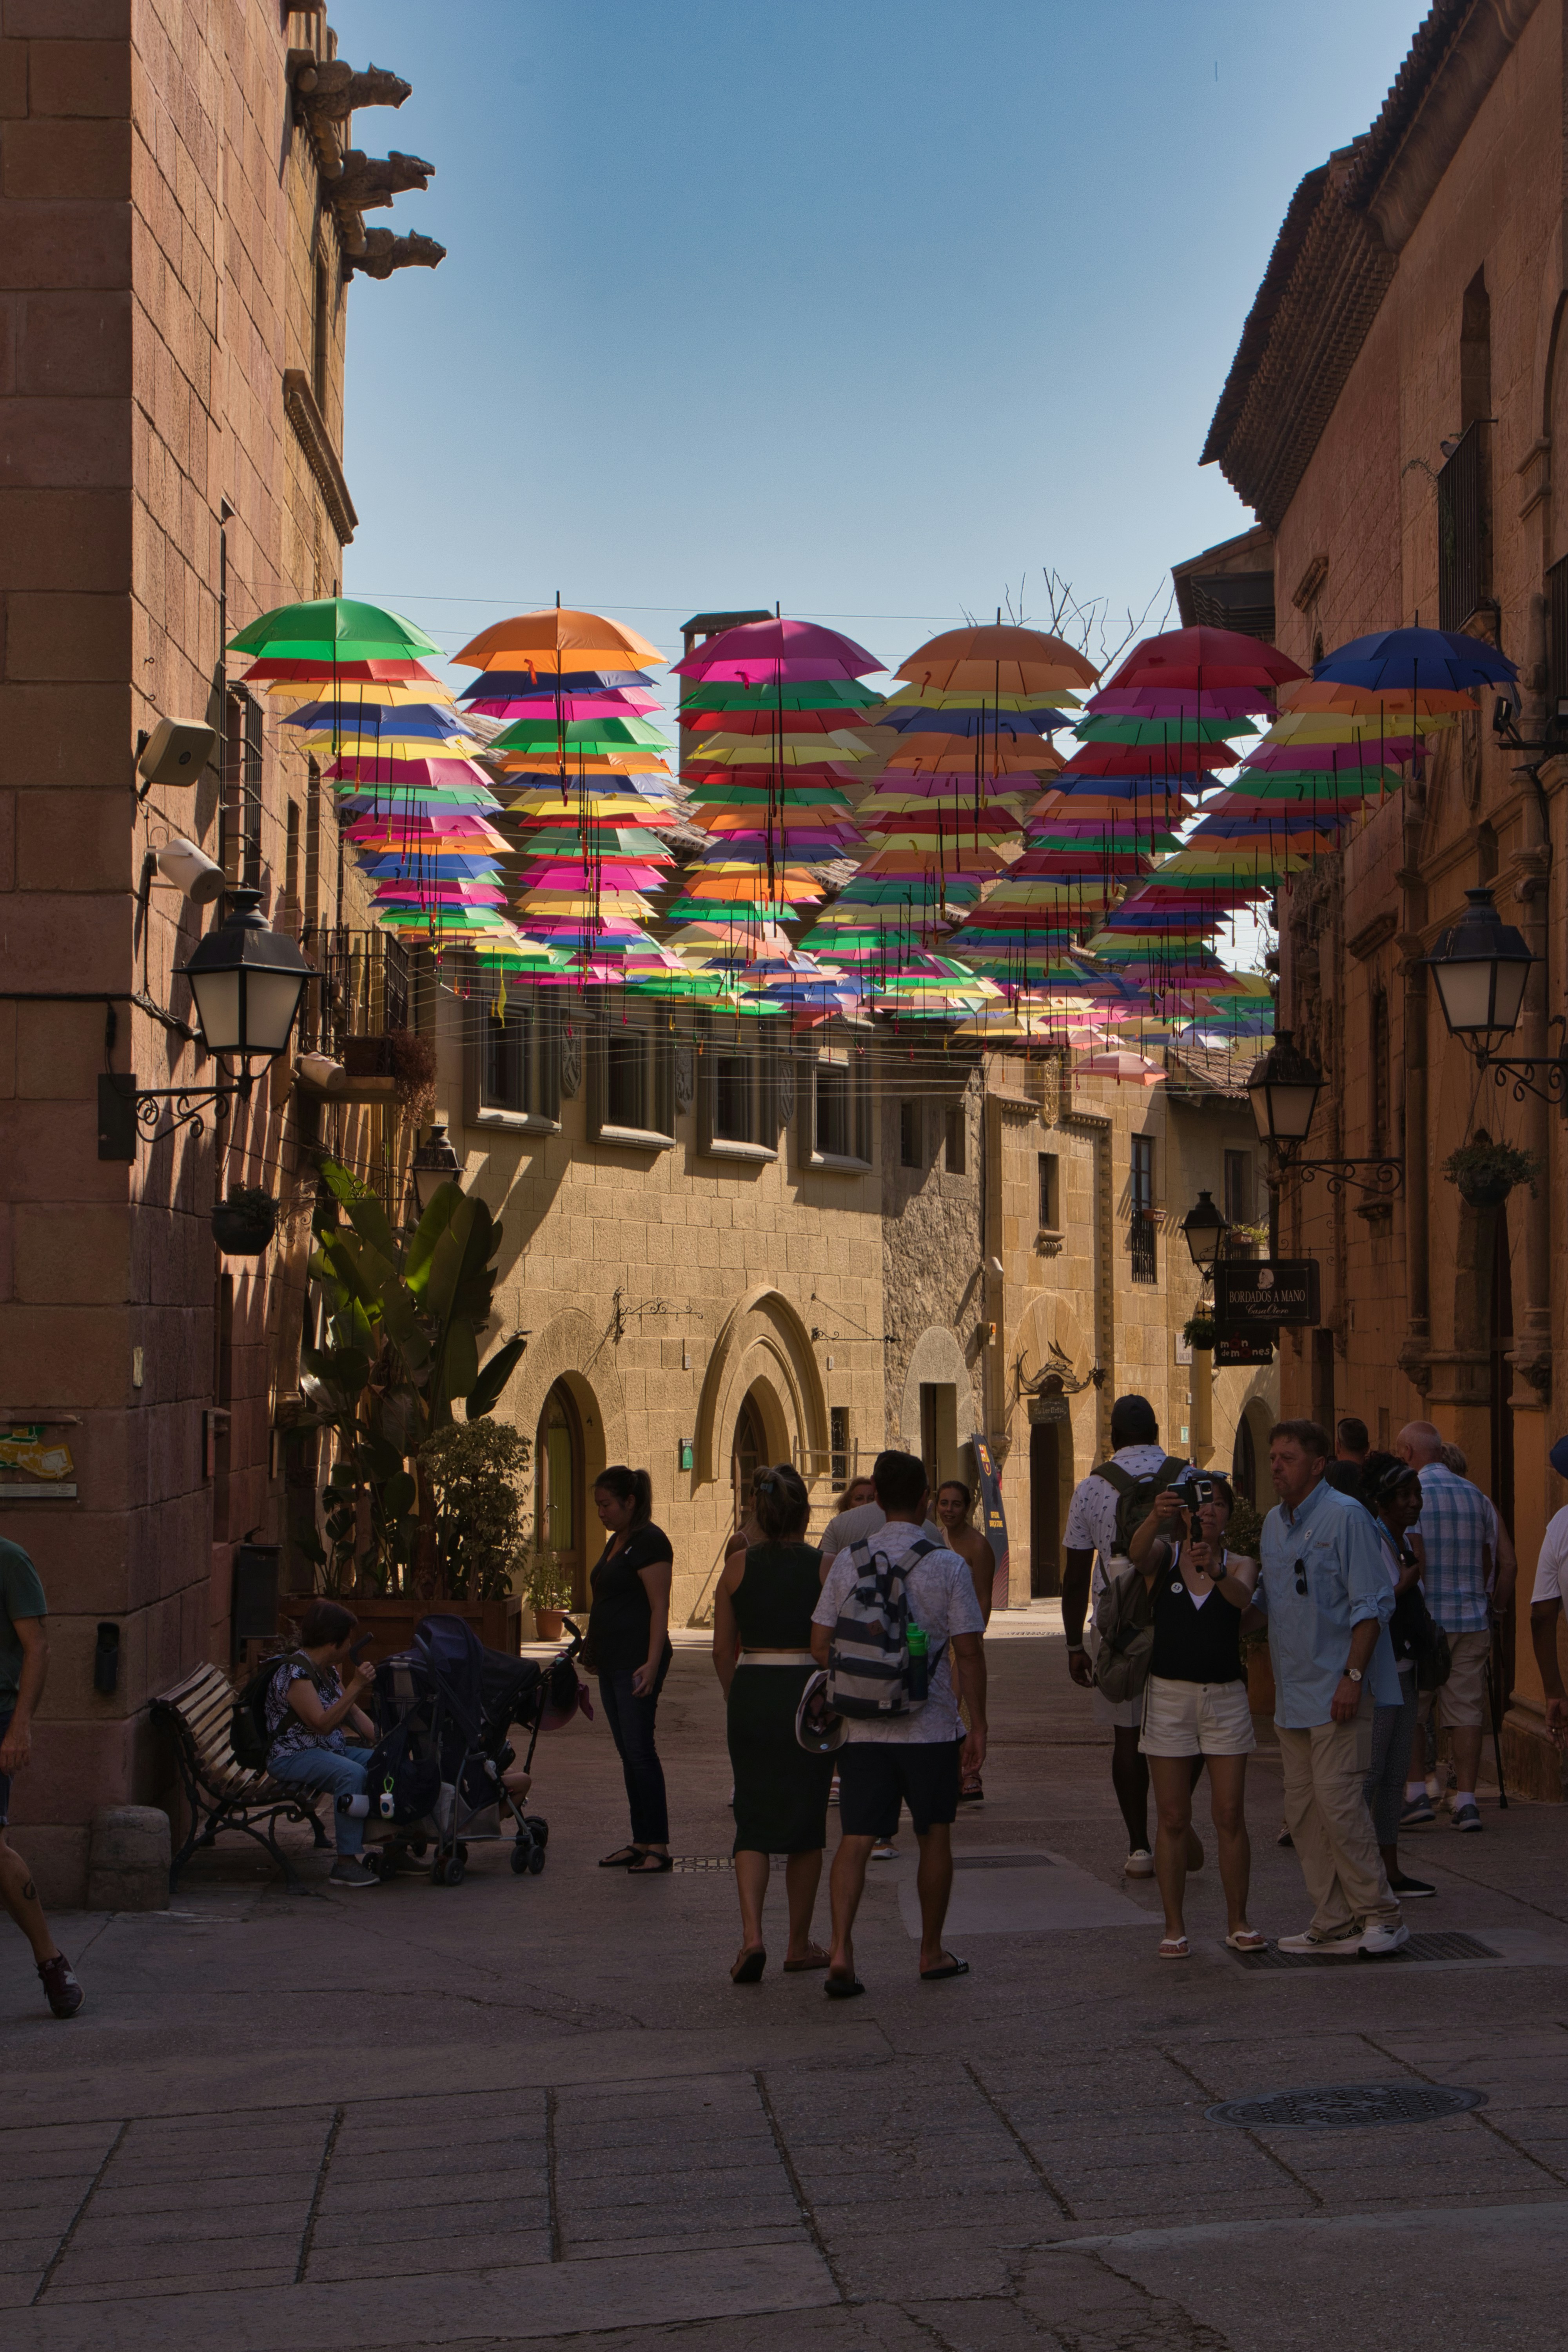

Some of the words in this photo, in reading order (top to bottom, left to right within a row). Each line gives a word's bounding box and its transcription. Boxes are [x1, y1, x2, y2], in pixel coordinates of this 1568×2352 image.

[1229, 1290, 1271, 1303] BORDADOS
[1274, 1290, 1279, 1302] A
[1281, 1290, 1305, 1302] MANO
[1245, 1303, 1267, 1314] Casa
[1267, 1303, 1289, 1314] Otero
[1230, 1348, 1270, 1358] mones
